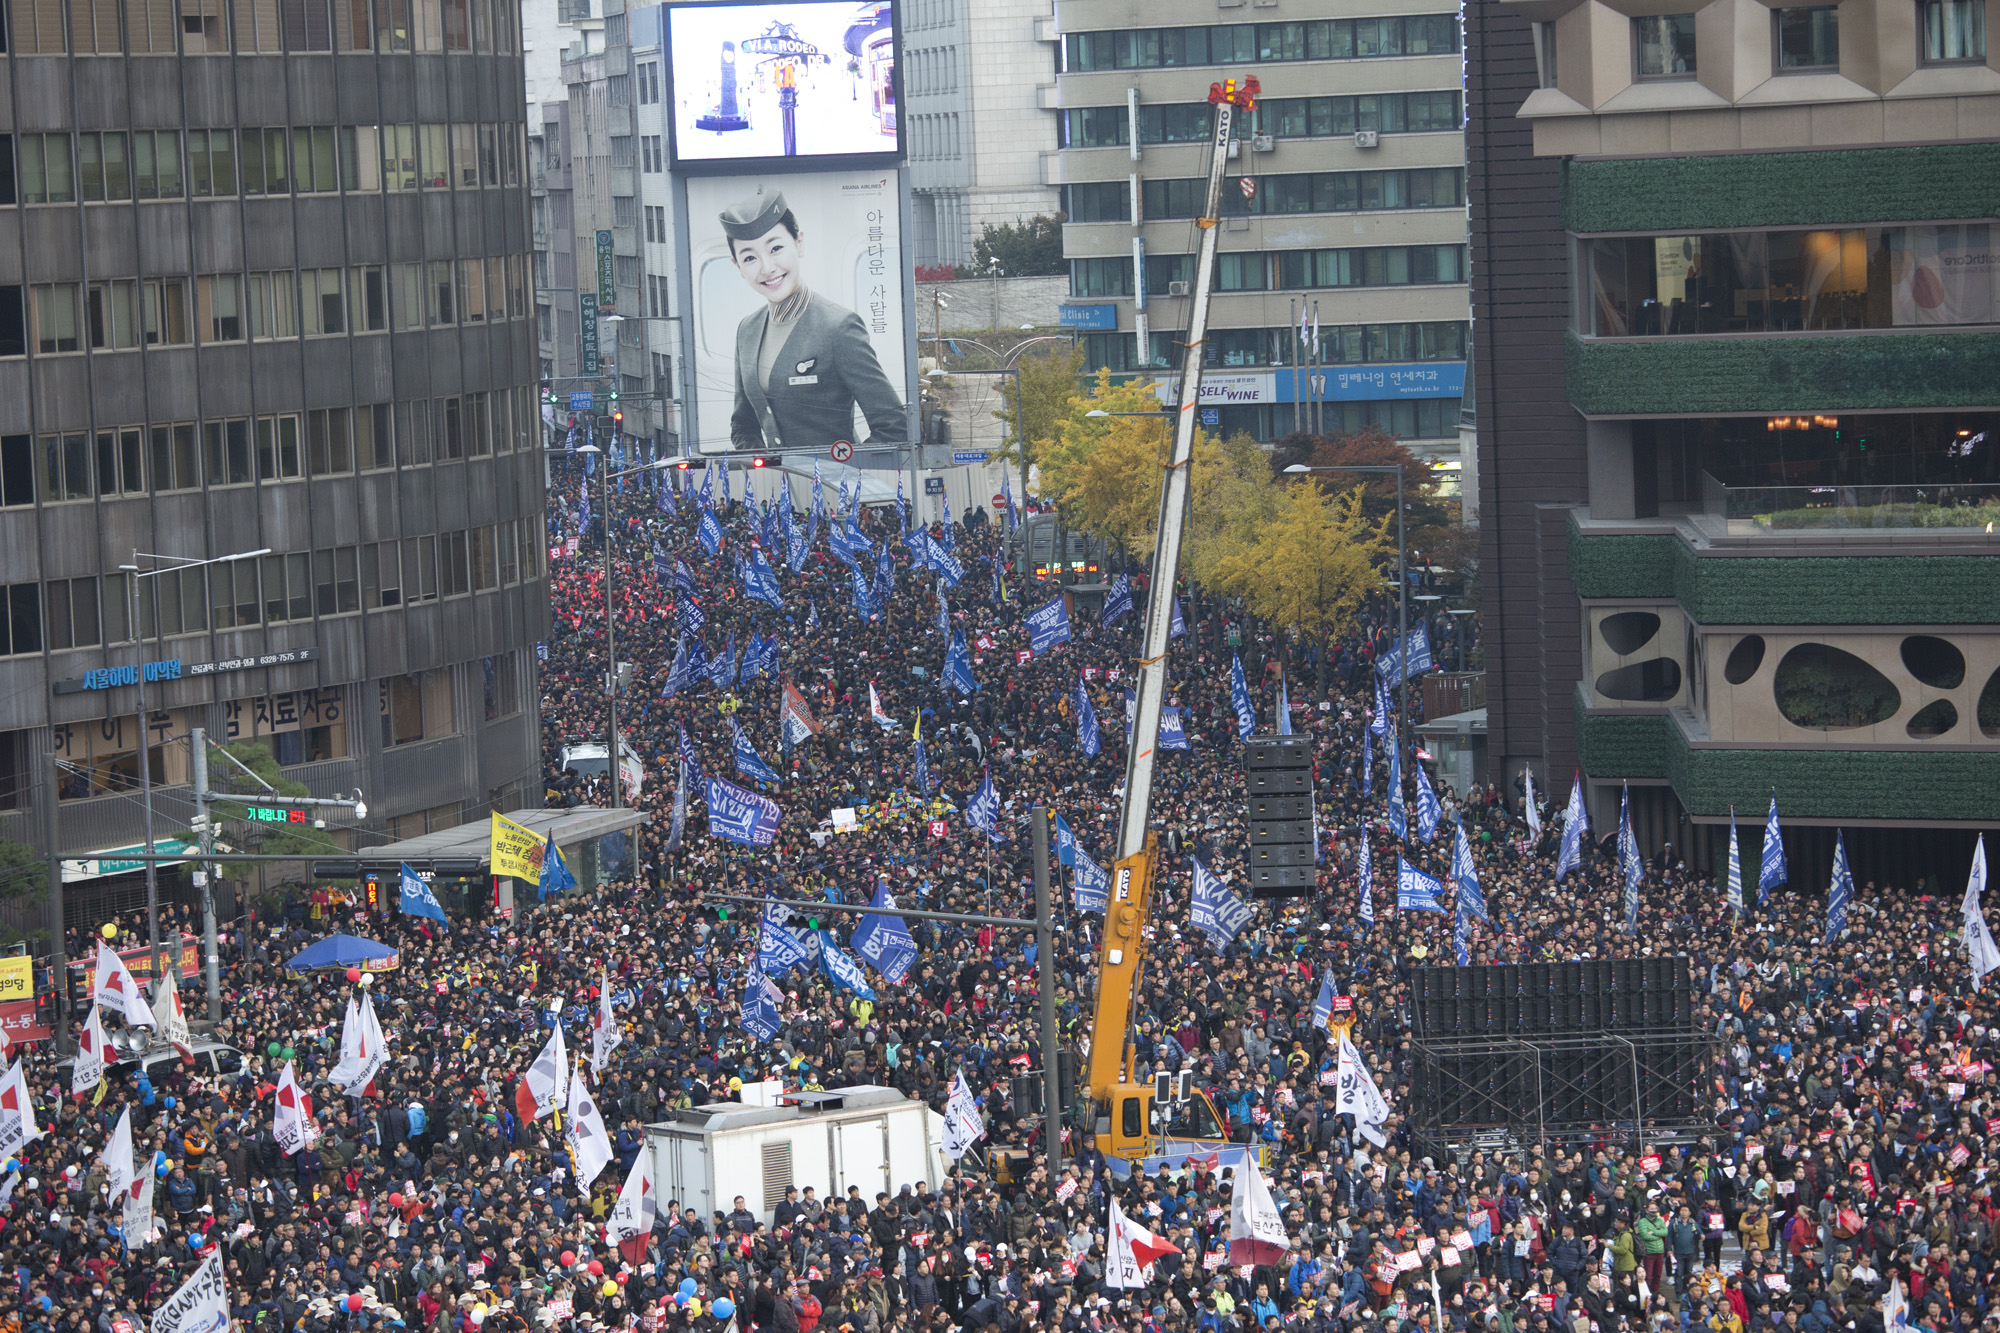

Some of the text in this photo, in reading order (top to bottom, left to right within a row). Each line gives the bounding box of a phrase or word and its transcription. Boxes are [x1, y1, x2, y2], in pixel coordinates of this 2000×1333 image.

[748, 39, 816, 54] VIA RODEO
[775, 63, 797, 88] LA
[1217, 110, 1230, 147] KATO
[866, 209, 885, 276] 아름다운
[869, 284, 888, 334] 사람들
[1068, 308, 1090, 319] Clinic
[1338, 370, 1438, 389] 밀레니엄 연세치과
[1199, 386, 1228, 397] SELF
[1226, 390, 1260, 400] WINE
[260, 653, 295, 664] 6328-7575
[301, 651, 309, 659] 2F
[191, 664, 213, 674] 진료과목
[1461, 736, 1467, 744] 2
[257, 808, 287, 822] 바랍니다
[931, 822, 944, 836] 진
[496, 841, 522, 857] 박근혜
[1120, 869, 1131, 899] KATO
